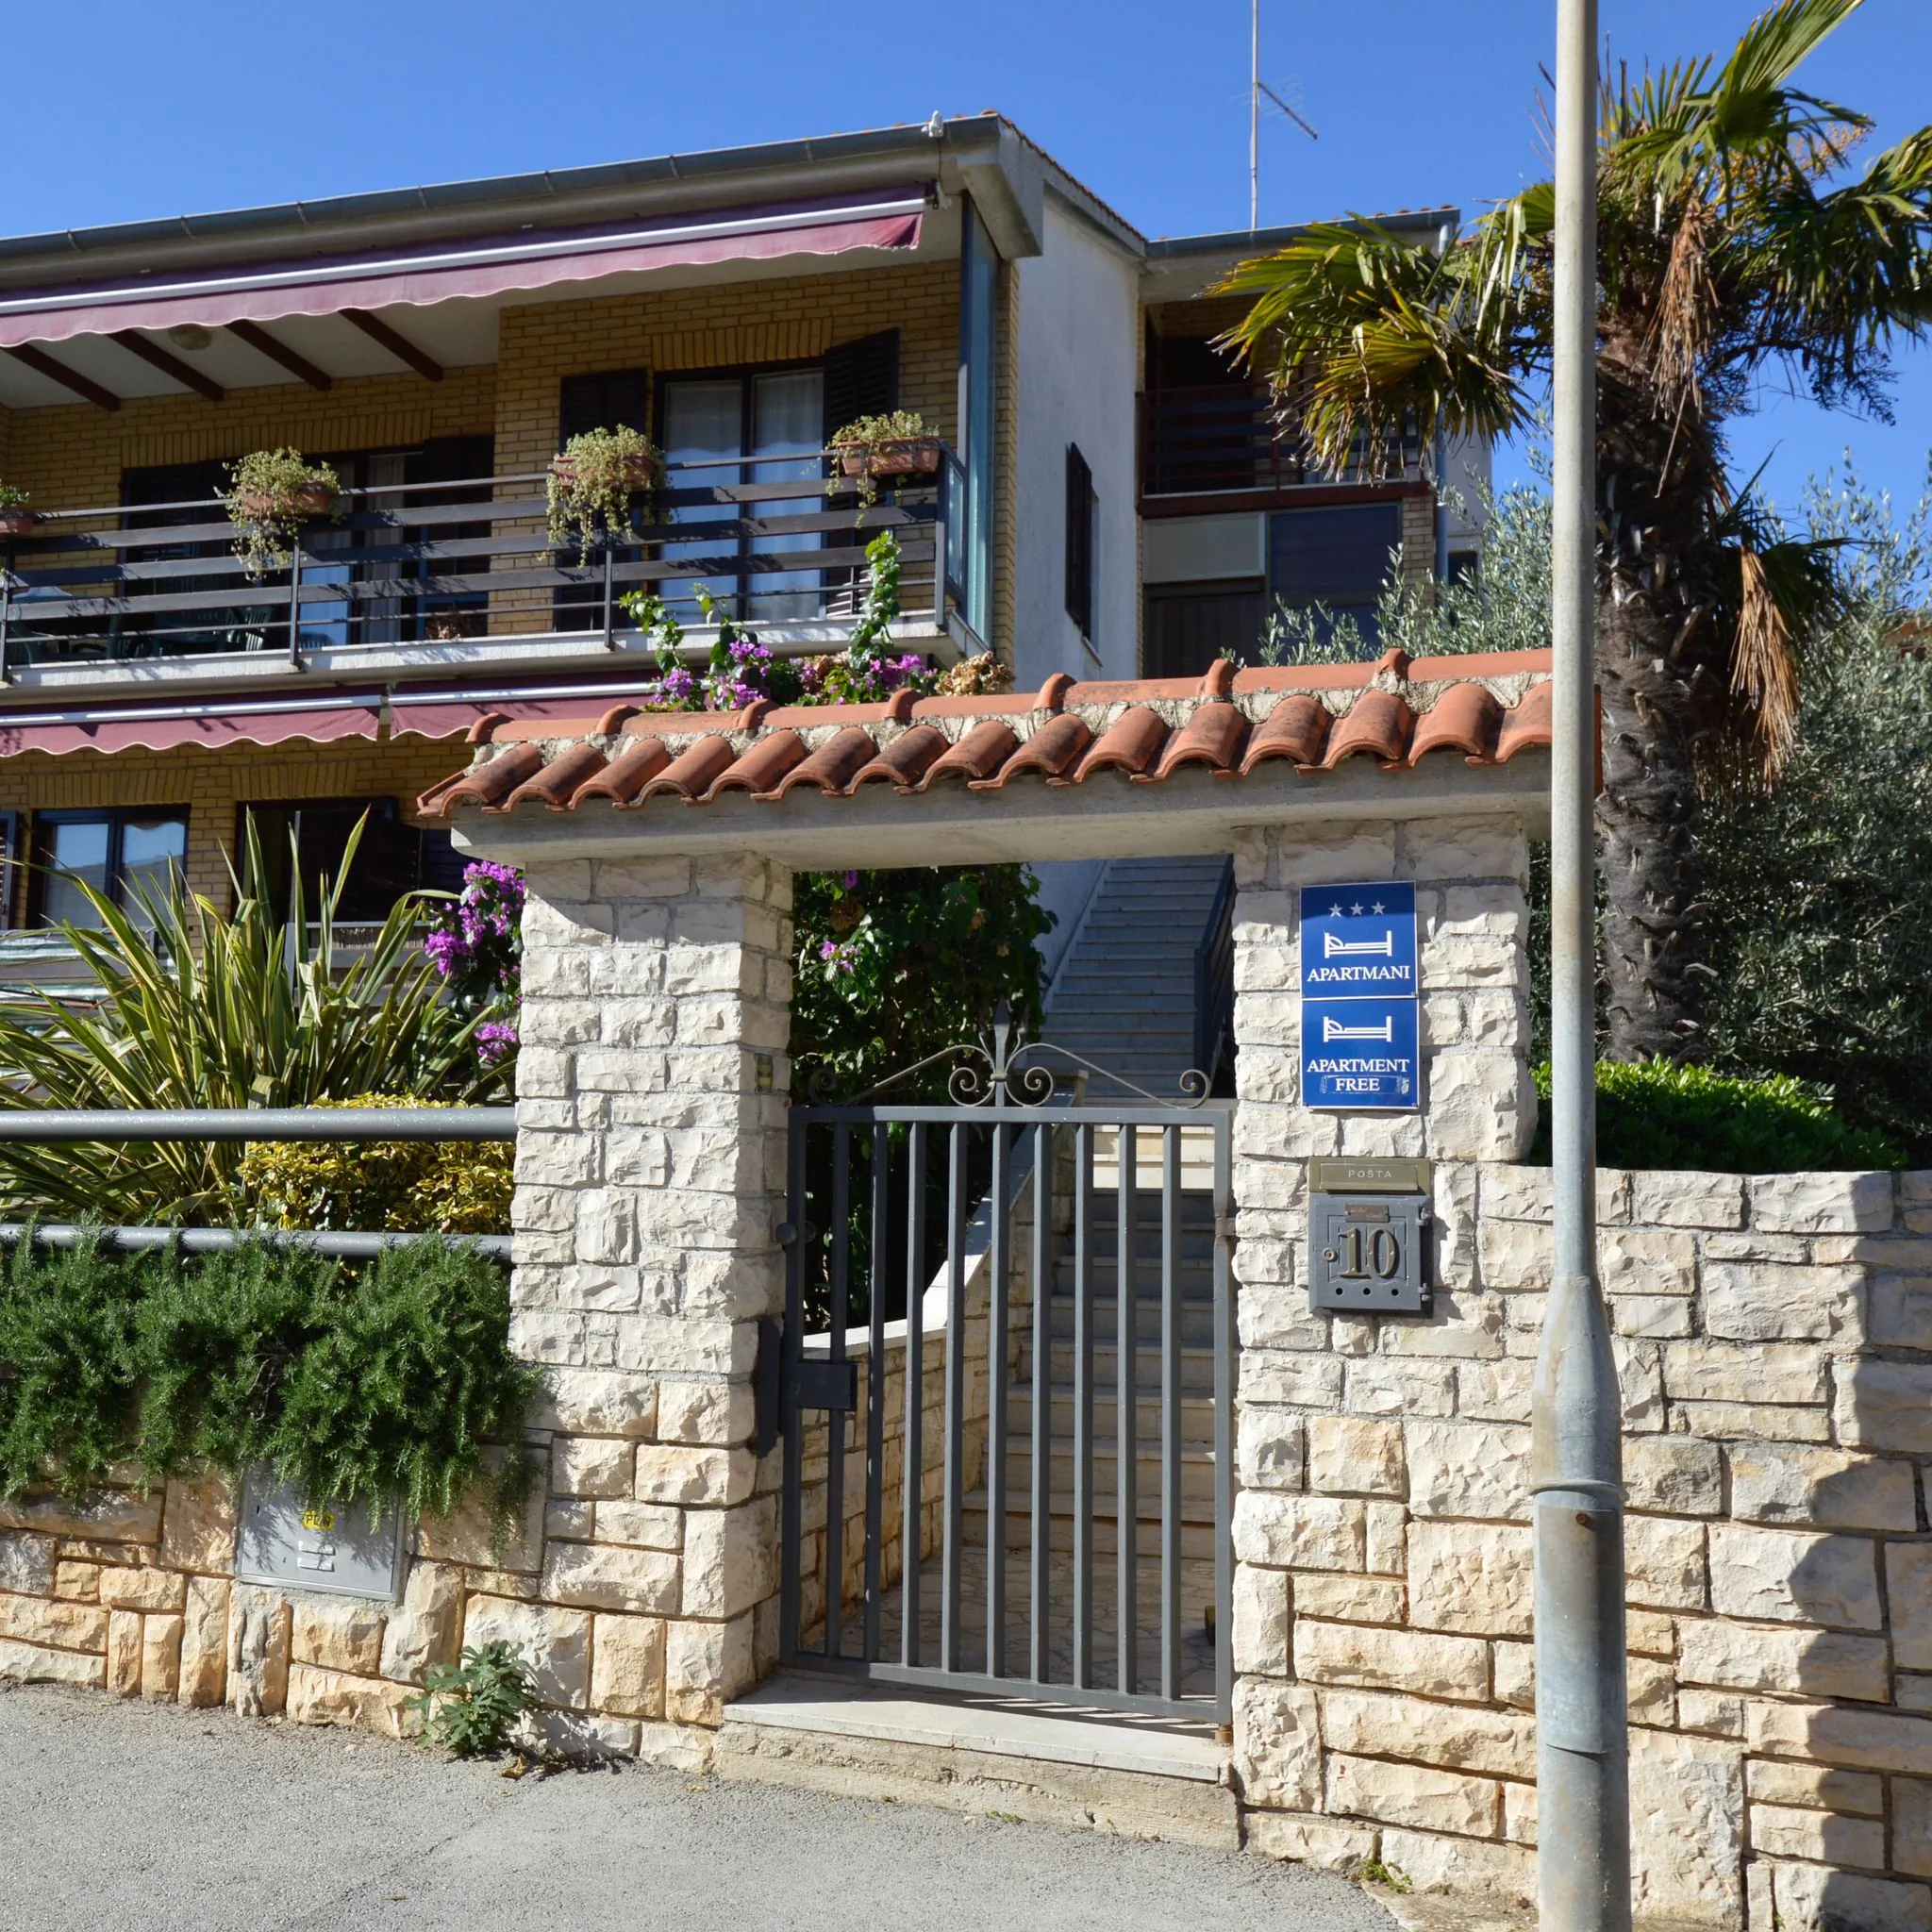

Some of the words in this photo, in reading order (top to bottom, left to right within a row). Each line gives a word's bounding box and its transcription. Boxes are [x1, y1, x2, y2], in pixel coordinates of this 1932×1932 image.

[1307, 965, 1410, 982] APARTMANI
[1307, 1058, 1410, 1073] APARTMENT
[1335, 1077, 1381, 1091] FREE
[1348, 1169, 1392, 1178] POSTA
[1338, 1227, 1396, 1277] 10
